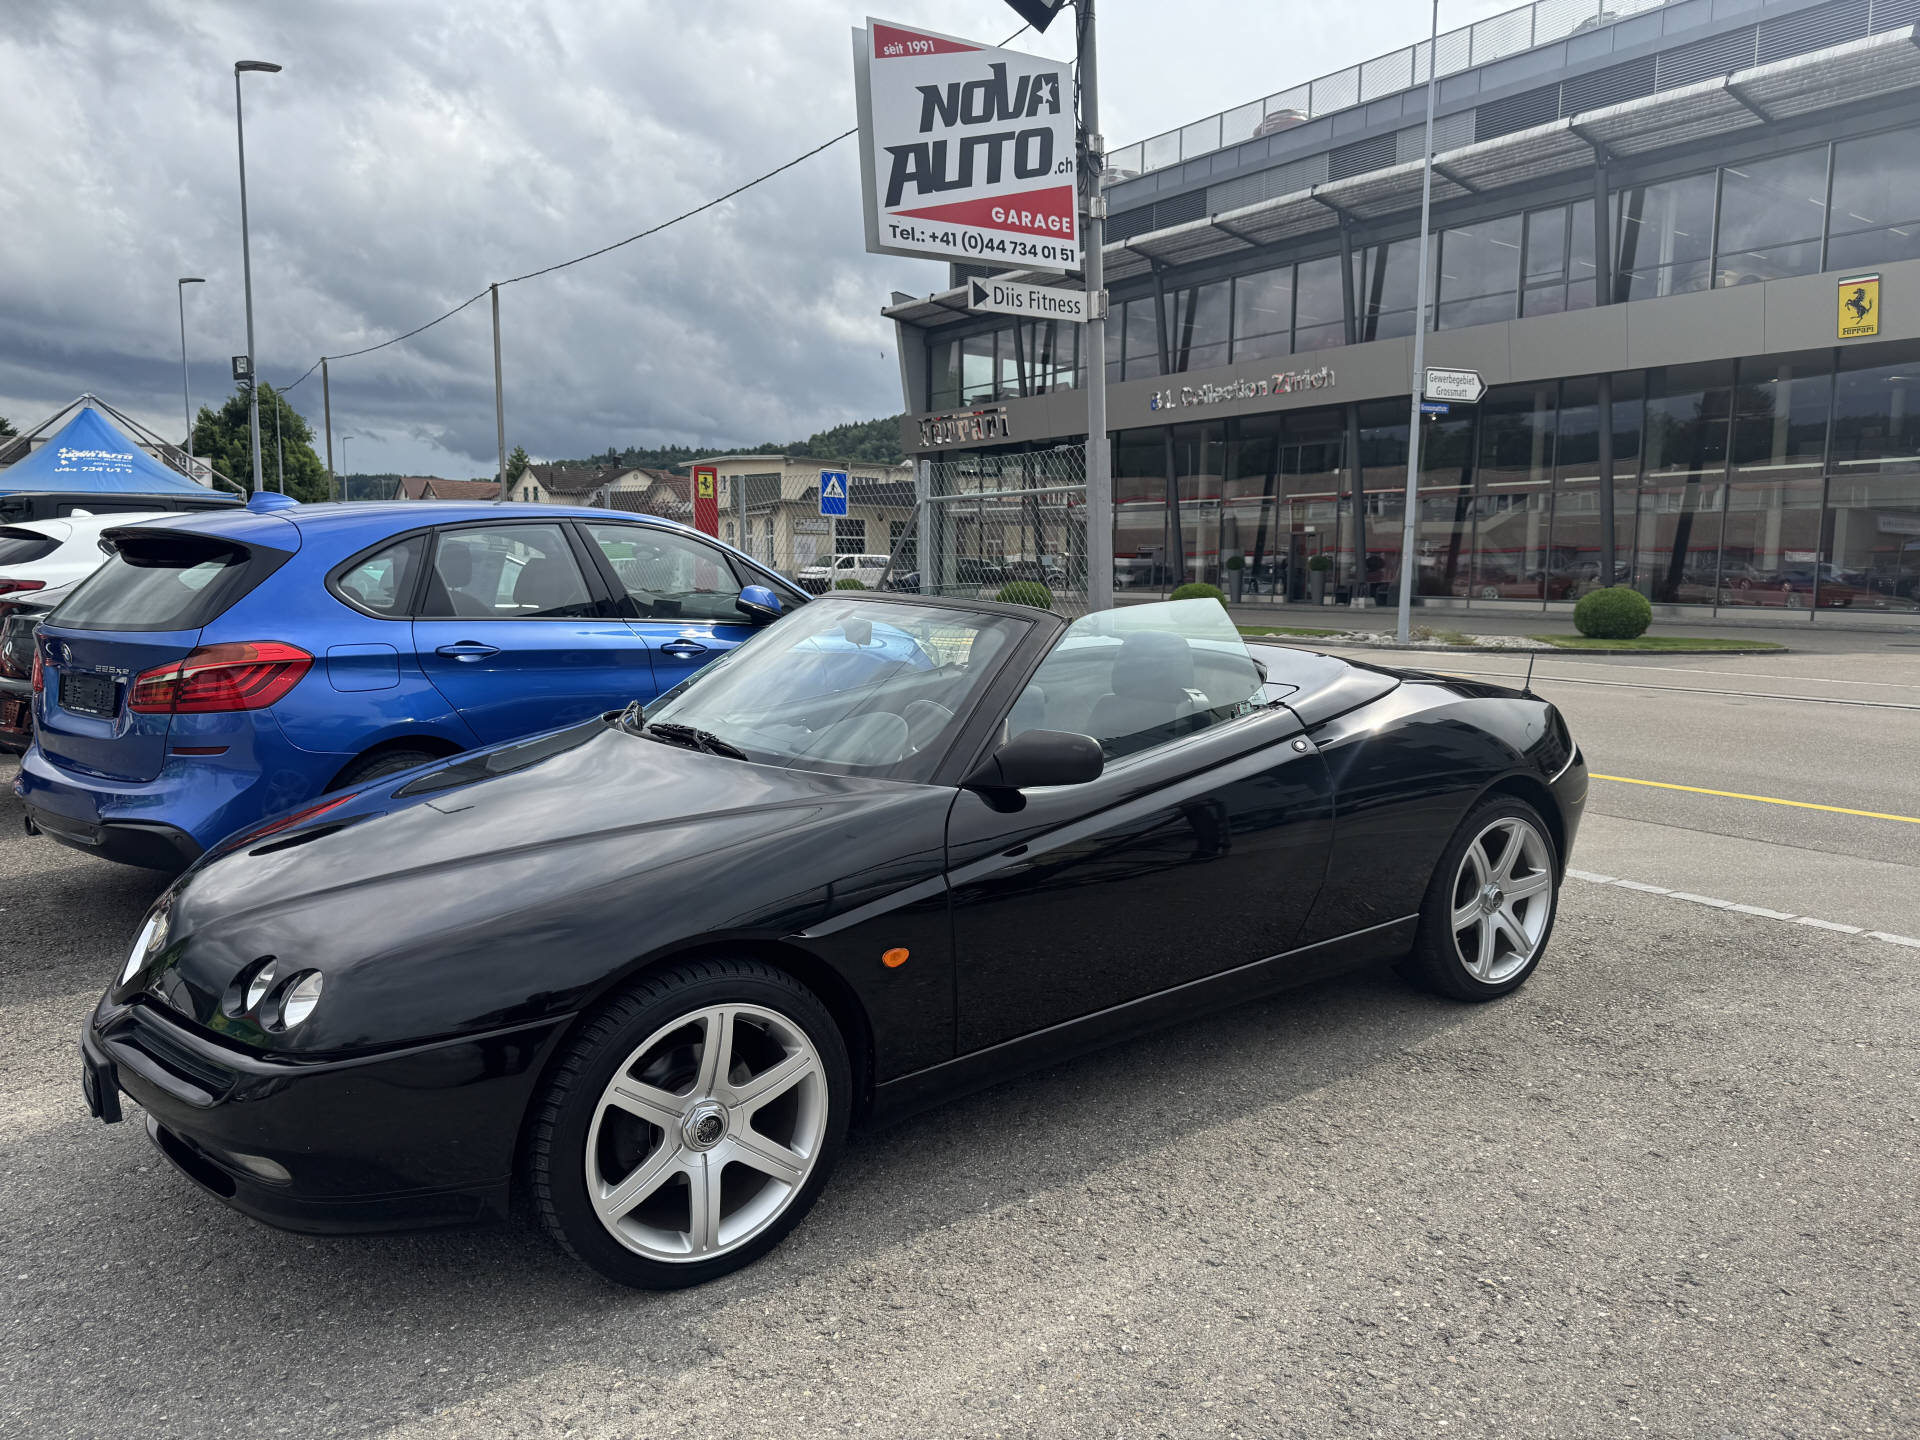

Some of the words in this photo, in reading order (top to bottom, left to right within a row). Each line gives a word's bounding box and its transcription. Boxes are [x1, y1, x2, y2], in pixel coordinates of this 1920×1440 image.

[883, 40, 903, 56] seit
[907, 40, 935, 54] 1991
[915, 62, 1061, 133] NOVA
[883, 126, 1054, 208] AUTO
[1054, 157, 1073, 175] .ch
[991, 207, 1071, 233] GARAGE
[889, 224, 925, 243] Tel.:
[929, 231, 957, 247] +41
[962, 231, 1007, 254] (0)44
[1009, 241, 1038, 258] 734
[1041, 246, 1057, 260] 01
[1060, 247, 1075, 262] 51
[993, 286, 1023, 308] Diis
[1029, 291, 1081, 315] Fitness
[1181, 379, 1269, 407] Collection
[1272, 366, 1336, 395] Zürich
[1430, 372, 1475, 386] Gewerbegebiet
[1436, 386, 1467, 397] Grossmatt
[918, 406, 1010, 447] Ferrari
